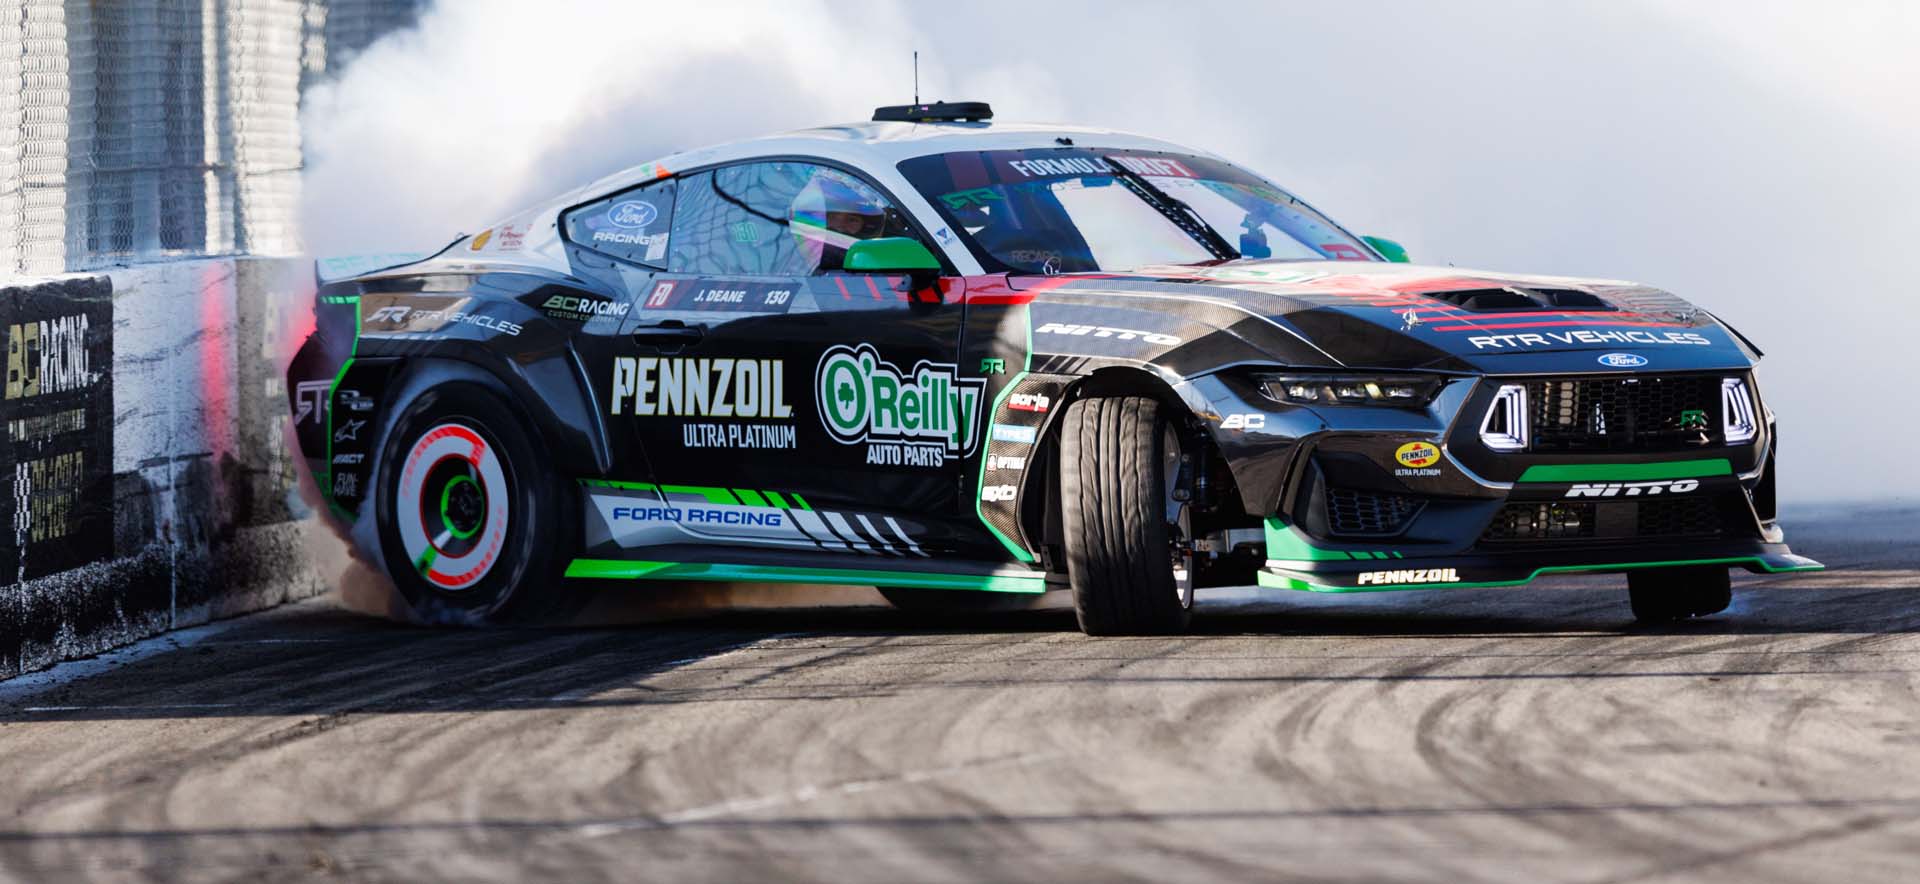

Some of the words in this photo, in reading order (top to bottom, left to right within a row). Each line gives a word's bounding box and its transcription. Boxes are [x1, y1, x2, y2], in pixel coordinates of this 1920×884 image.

[1008, 157, 1113, 176] FORMULA
[614, 204, 648, 223] Ford
[593, 231, 650, 245] RACING
[694, 290, 705, 303] J.
[706, 290, 746, 303] DEANE
[764, 290, 790, 305] 130
[411, 310, 443, 321] RTR
[443, 311, 524, 337] VEHICLES
[546, 310, 578, 321] CUSTOM
[1035, 322, 1182, 345] NITTO
[1468, 333, 1550, 349] RTR
[1546, 330, 1711, 345] VEHICLES
[1607, 354, 1640, 366] Ford
[611, 356, 793, 419] PENNZOIL
[825, 358, 974, 444] O'Reilly
[1220, 414, 1265, 429] BC
[683, 423, 726, 448] ULTRA
[729, 424, 796, 449] PLATINUM
[866, 444, 900, 465] AUTO
[904, 446, 943, 467] PARTS
[1401, 448, 1436, 461] PENNZOIL
[1394, 468, 1412, 477] ULTRA
[1413, 468, 1441, 477] PLATINUM
[1565, 479, 1699, 497] NITTO
[613, 507, 682, 522] FORD
[688, 509, 782, 526] RACING
[1358, 568, 1461, 585] PENNZOIL
